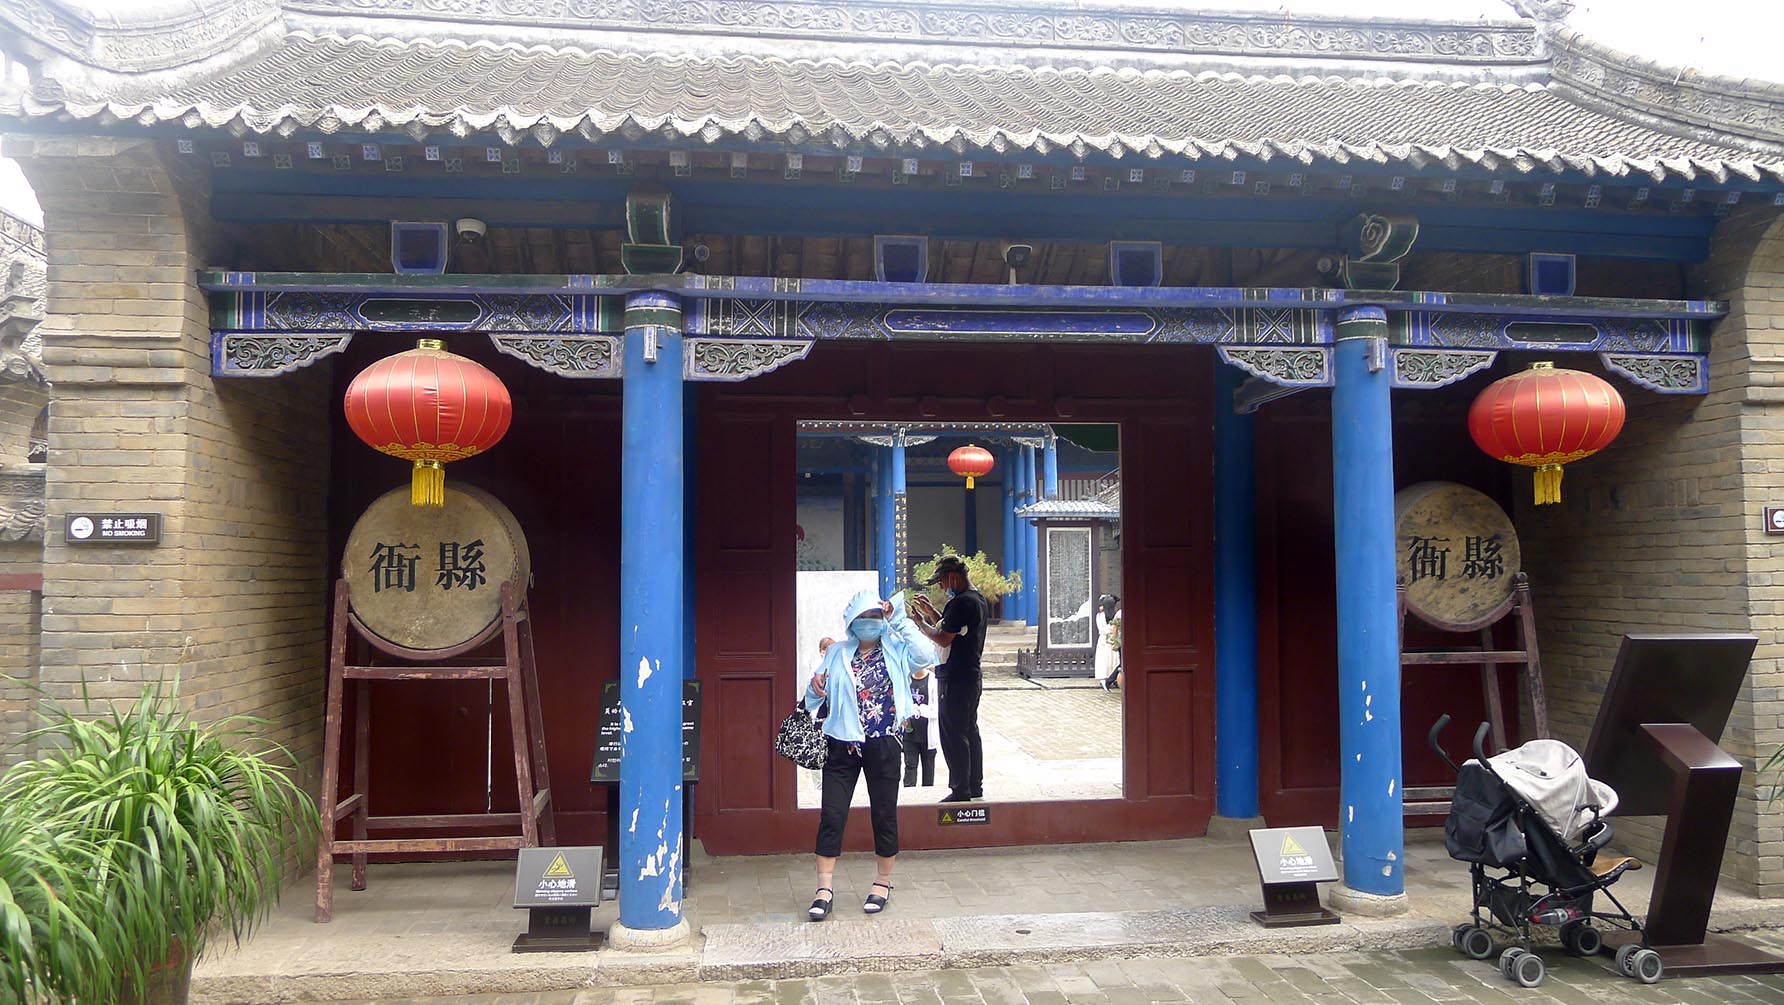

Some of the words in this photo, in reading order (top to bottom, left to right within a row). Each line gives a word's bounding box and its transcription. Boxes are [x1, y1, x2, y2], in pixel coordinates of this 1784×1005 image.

[101, 518, 148, 529] 禁止吸烟
[538, 879, 576, 889] 小心地滑
